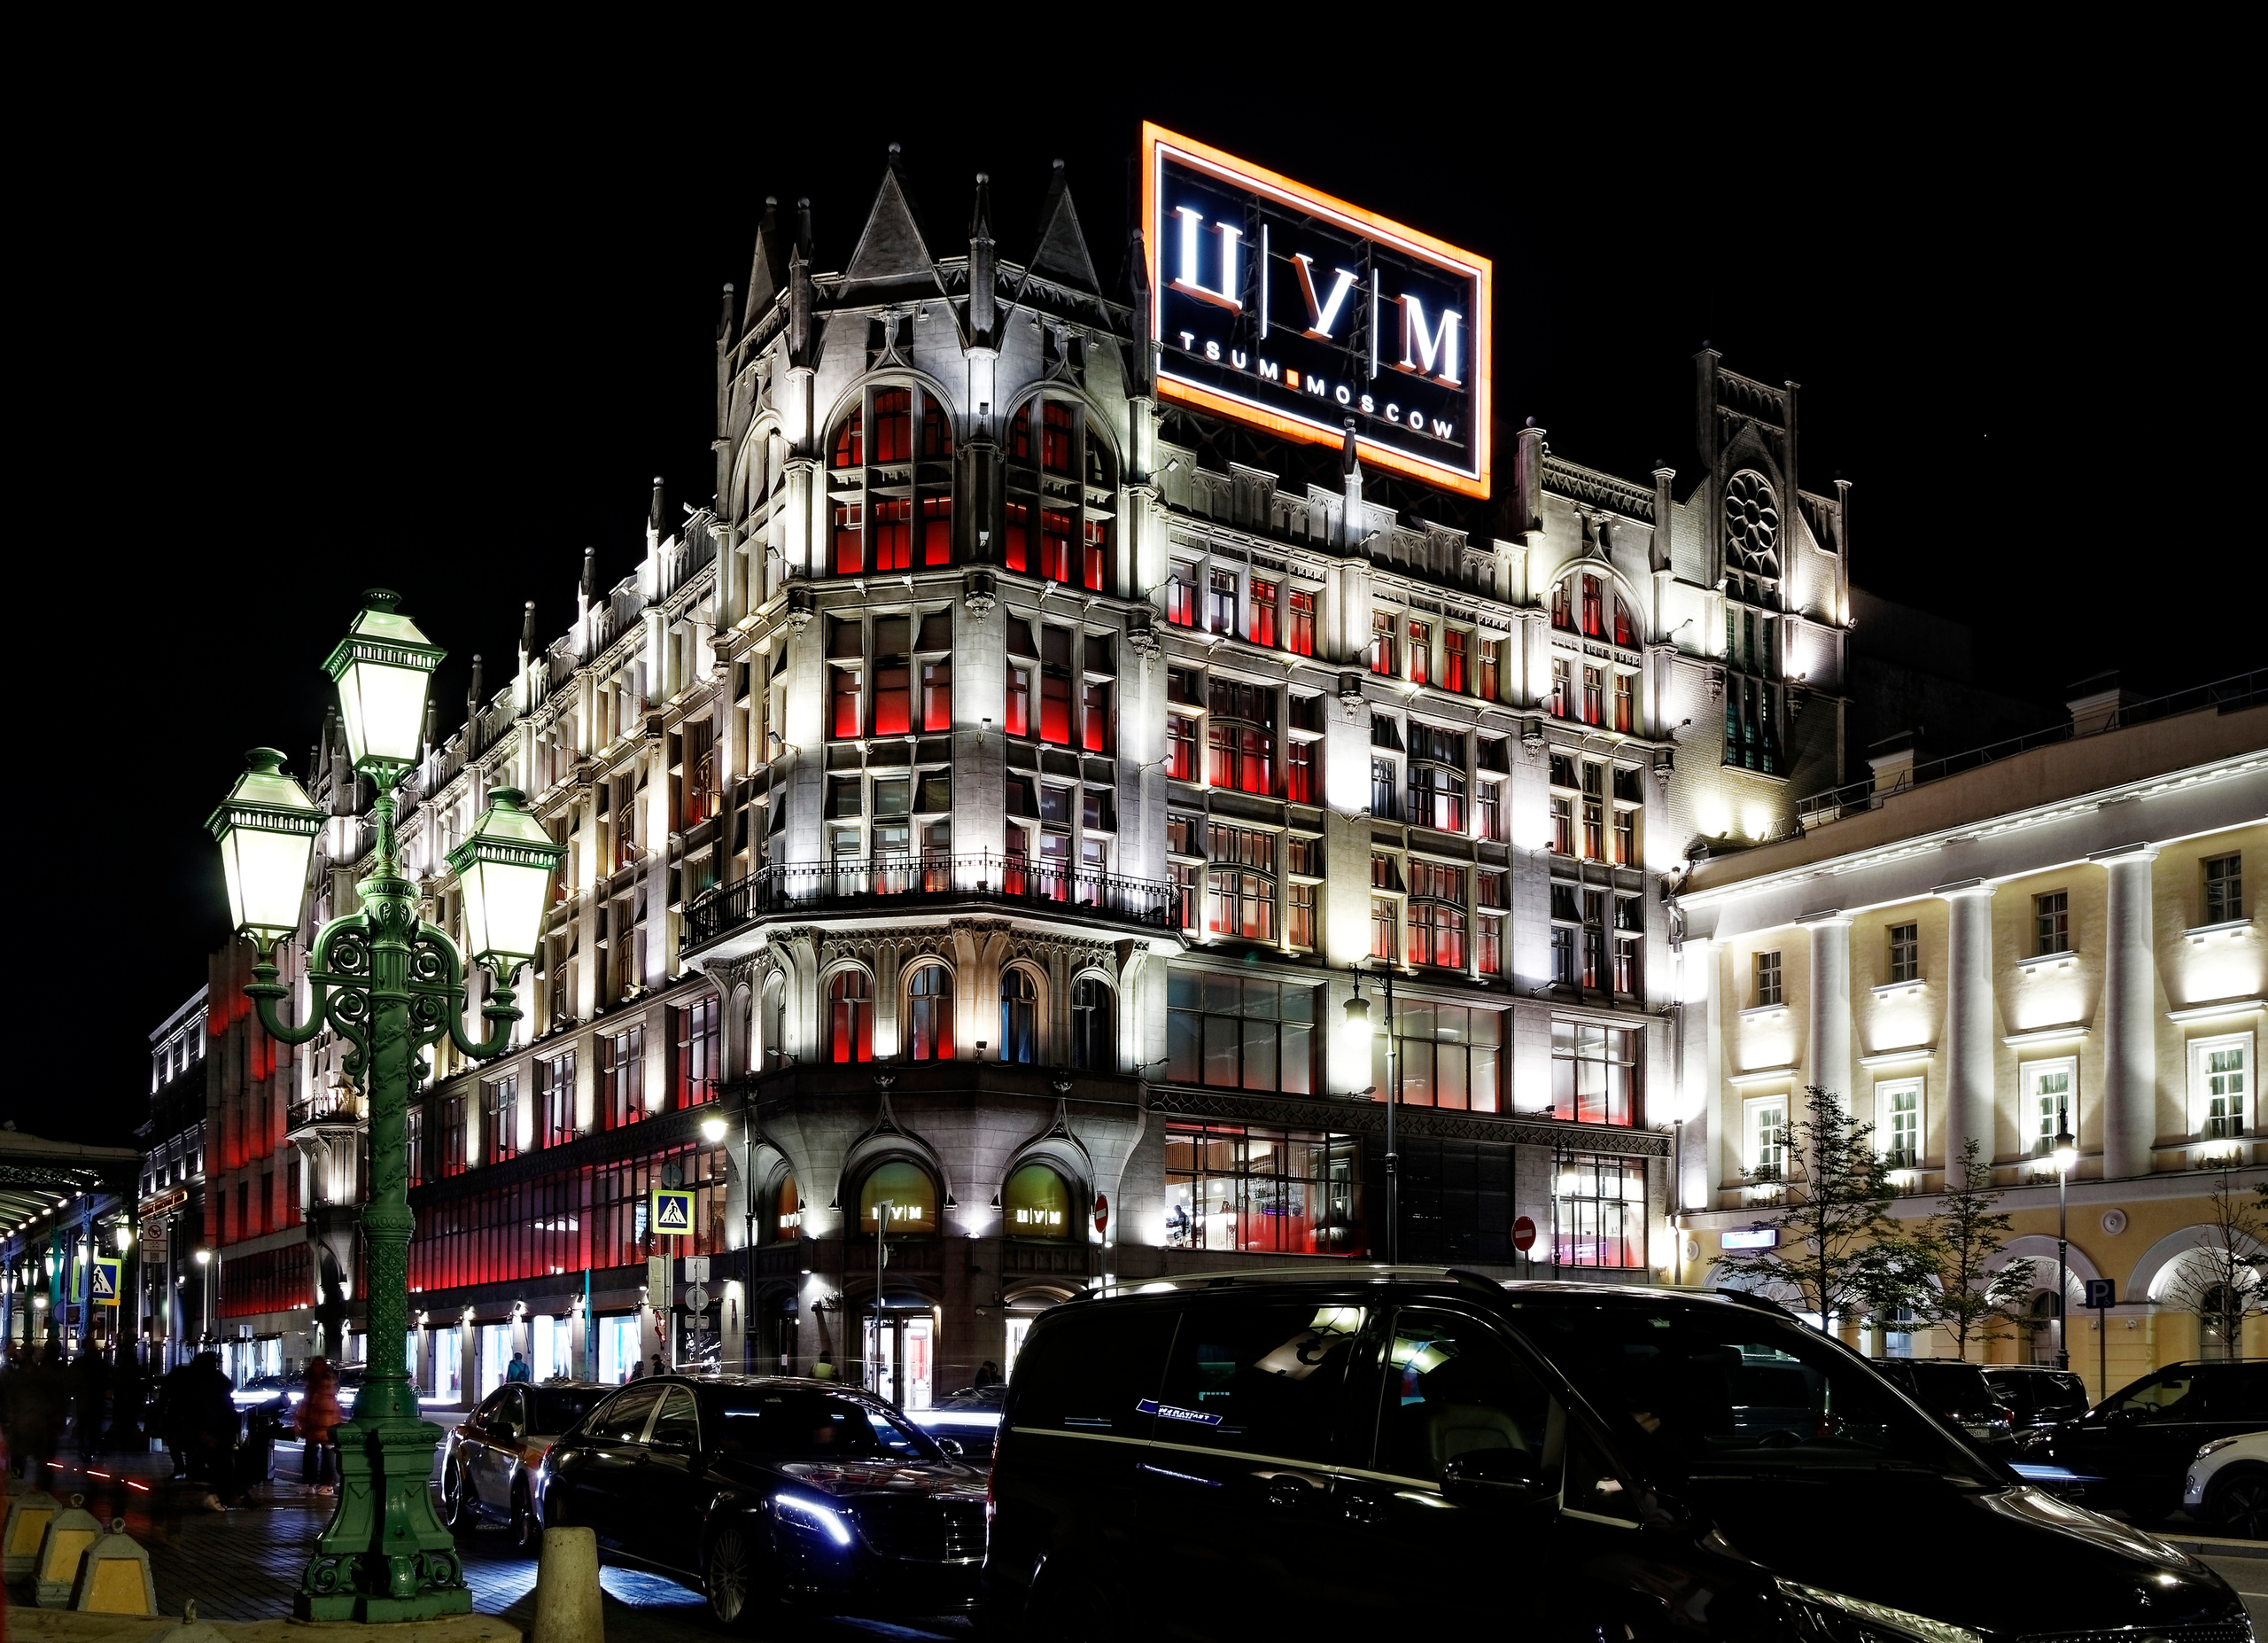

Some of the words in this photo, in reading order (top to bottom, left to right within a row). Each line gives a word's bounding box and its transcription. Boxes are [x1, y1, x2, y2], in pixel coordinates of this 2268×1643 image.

[1180, 331, 1279, 381] TSUM
[1306, 375, 1453, 440] MOSCOW
[2092, 1281, 2109, 1306] P
